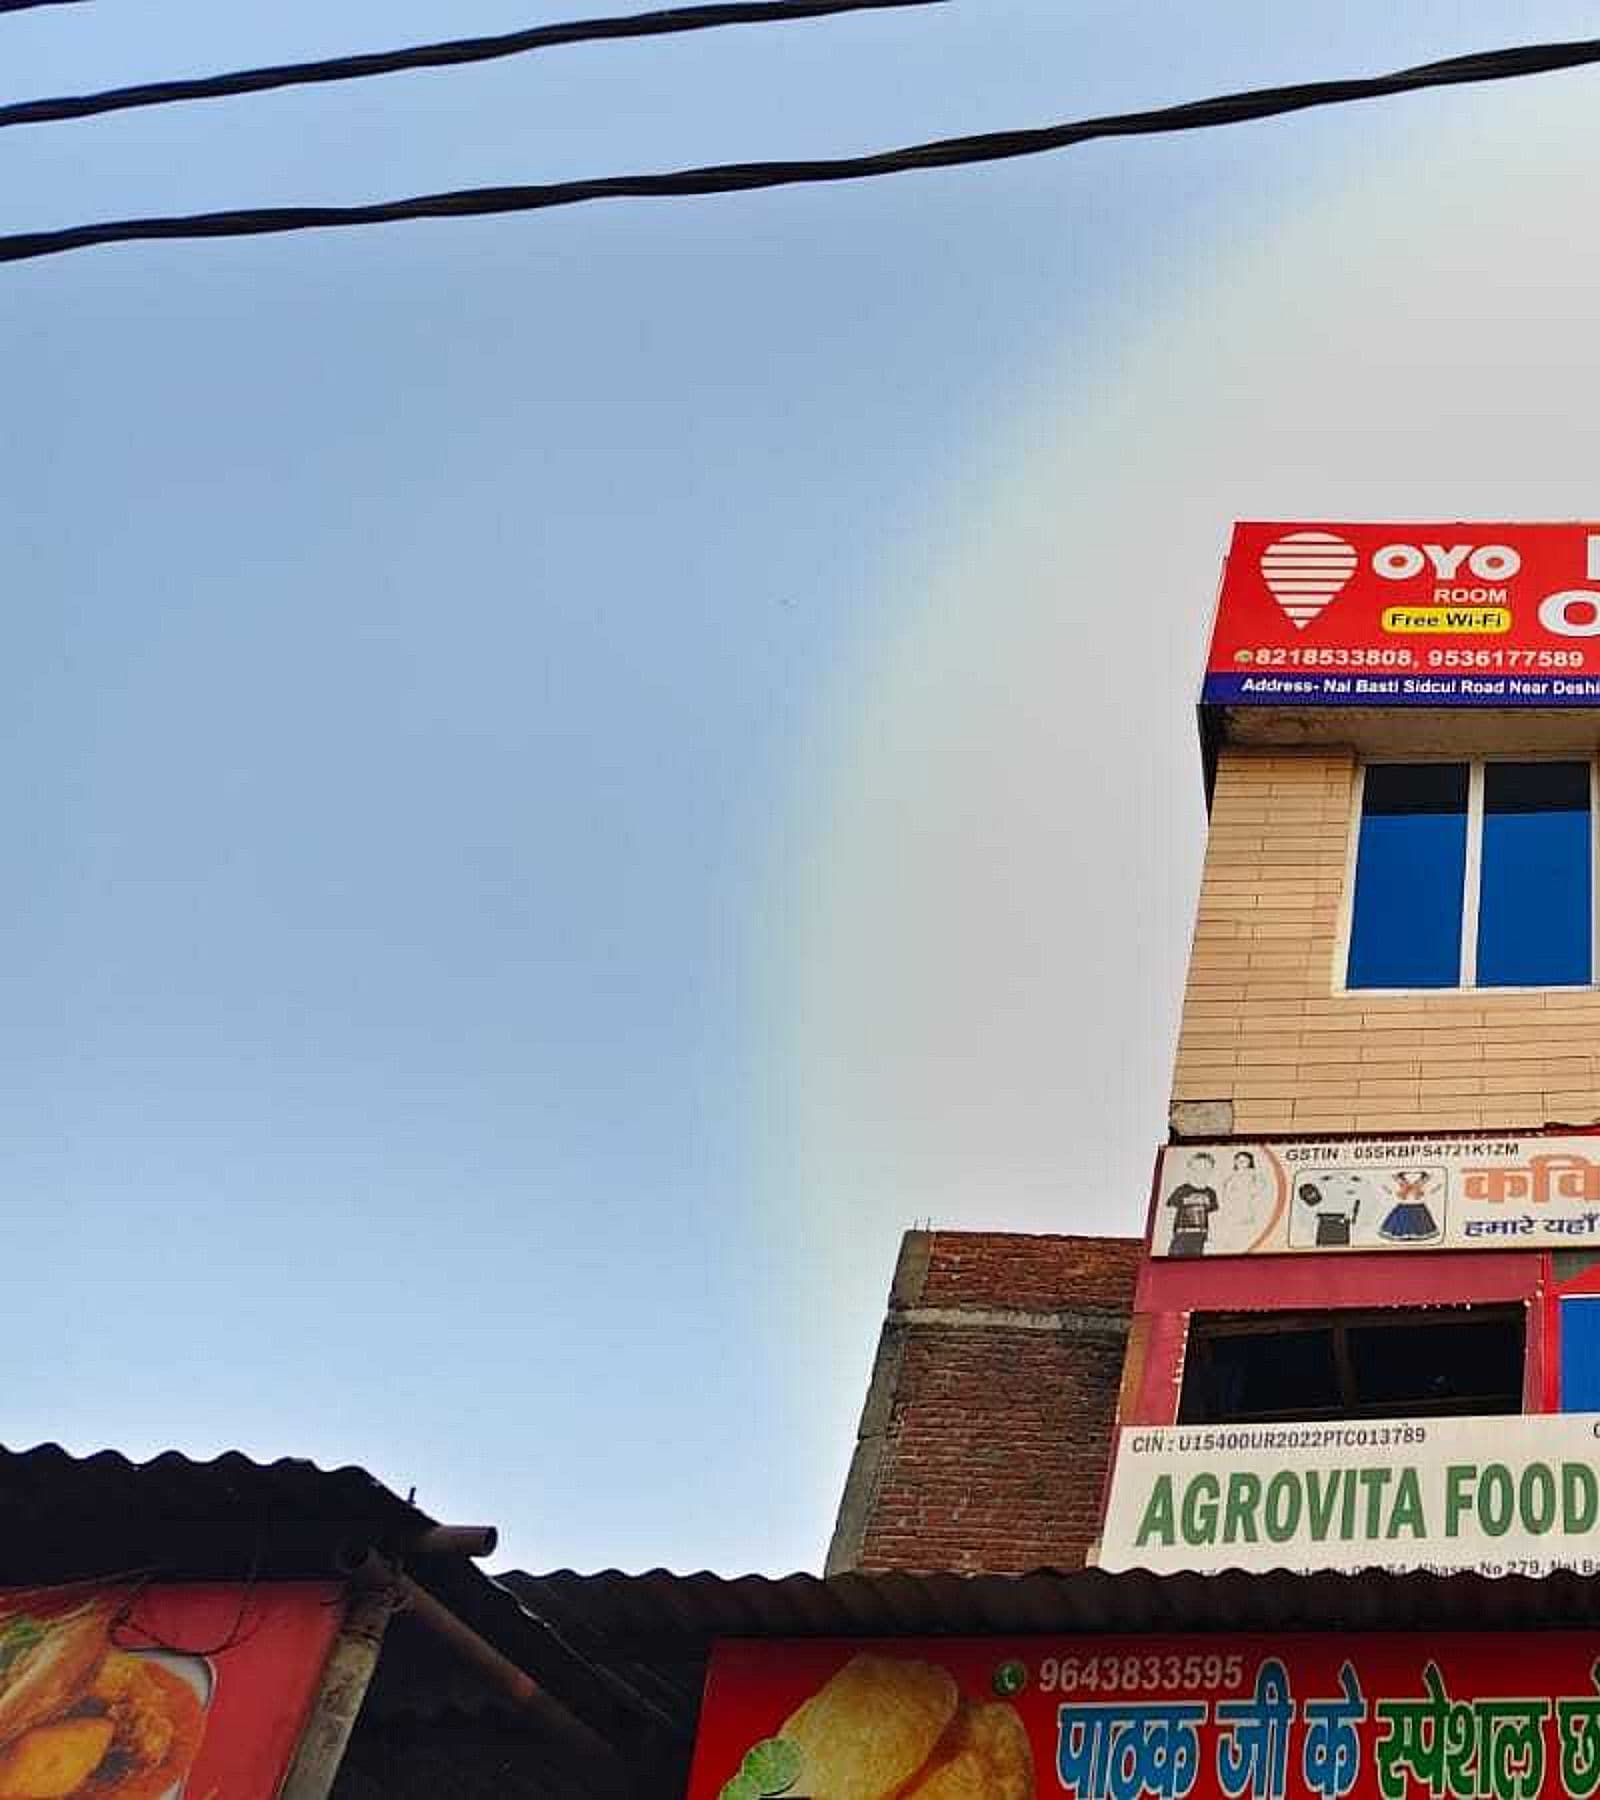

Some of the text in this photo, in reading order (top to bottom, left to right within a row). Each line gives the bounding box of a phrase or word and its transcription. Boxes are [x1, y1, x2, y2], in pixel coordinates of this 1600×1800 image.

[1371, 543, 1522, 581] OYO
[1433, 587, 1508, 604] ROOM
[1390, 610, 1504, 628] Free Wi-Fi
[1254, 648, 1585, 669] 8218533808, 9536177589
[1241, 677, 1320, 693] Address-
[1323, 678, 1351, 693] Nai
[1355, 678, 1399, 693] Basti
[1403, 678, 1456, 694] Sidcul
[1461, 679, 1505, 694] Road
[1509, 680, 1549, 695] Near
[1552, 681, 1600, 695] Deshi
[1285, 1147, 1338, 1161] GSTIN
[1464, 1214, 1538, 1238] हमारे
[1543, 1210, 1600, 1236] यहाँ
[1132, 1436, 1164, 1452] CIN
[1135, 1467, 1428, 1547] AGROVITA
[1039, 1655, 1243, 1692] 9643833595
[1056, 1701, 1208, 1800] पाठक
[1214, 1657, 1296, 1800] जी
[1302, 1660, 1367, 1800] के
[1375, 1660, 1552, 1800] स्पेशल
